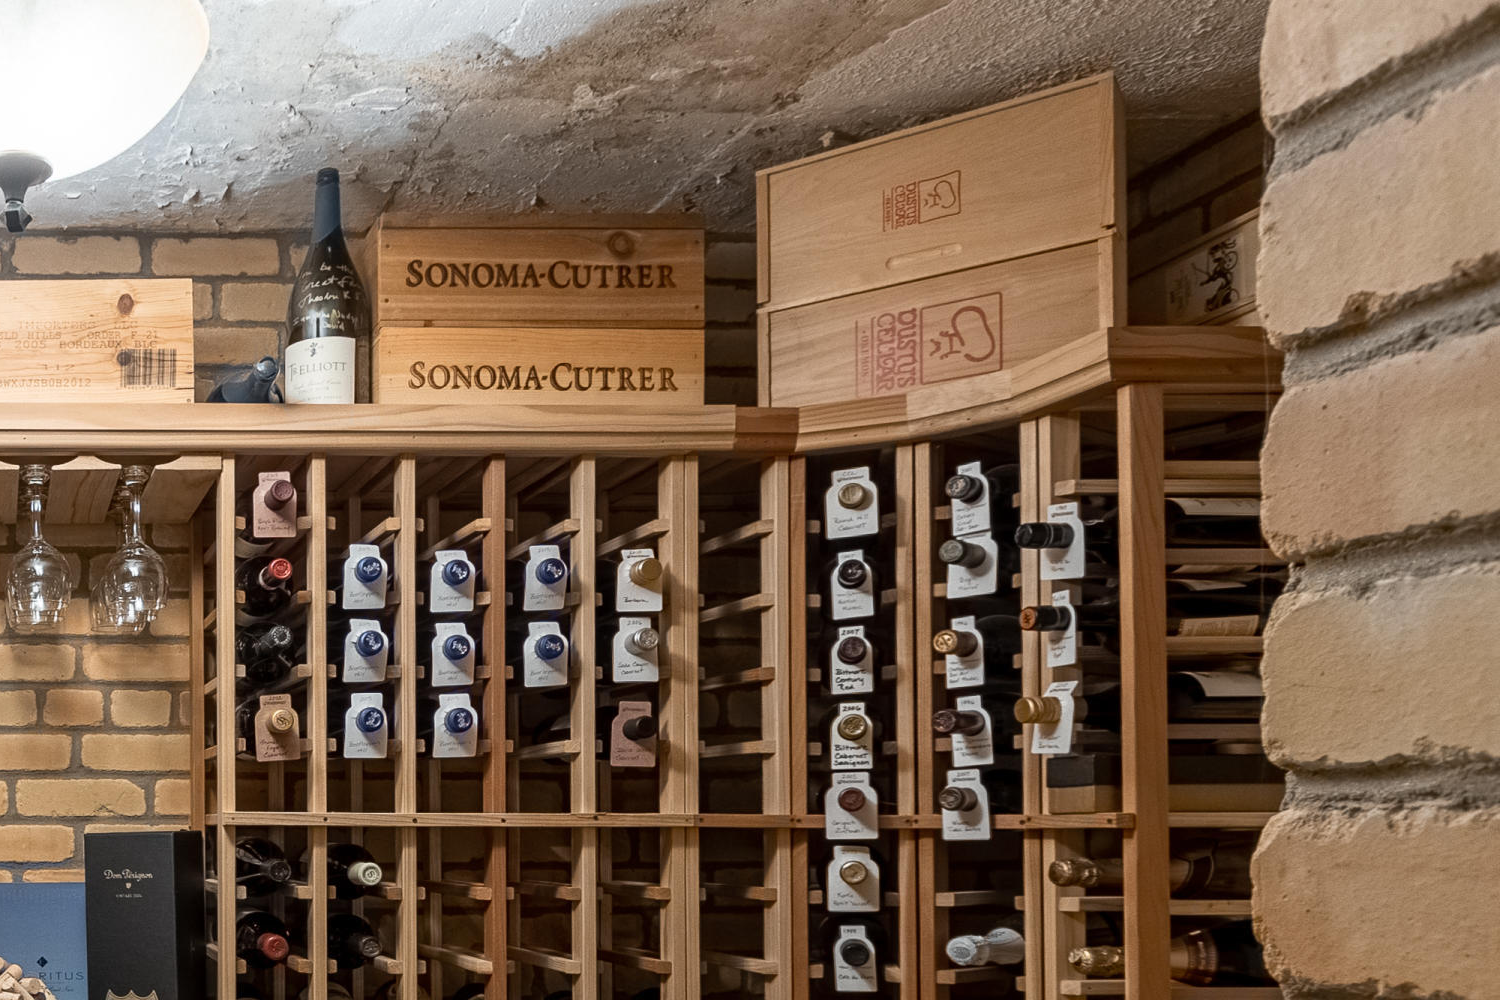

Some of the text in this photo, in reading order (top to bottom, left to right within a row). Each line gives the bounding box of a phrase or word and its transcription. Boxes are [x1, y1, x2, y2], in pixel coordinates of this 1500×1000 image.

[405, 259, 677, 289] SONOMA-CUTRER
[15, 340, 47, 349] 2005
[59, 340, 123, 349] BORDEAUX
[27, 331, 62, 340] HILLS
[87, 331, 122, 340] ORDER
[876, 312, 897, 393] CELLAR
[408, 361, 679, 391] SONOMA-CUTRER
[103, 869, 123, 880] Dom
